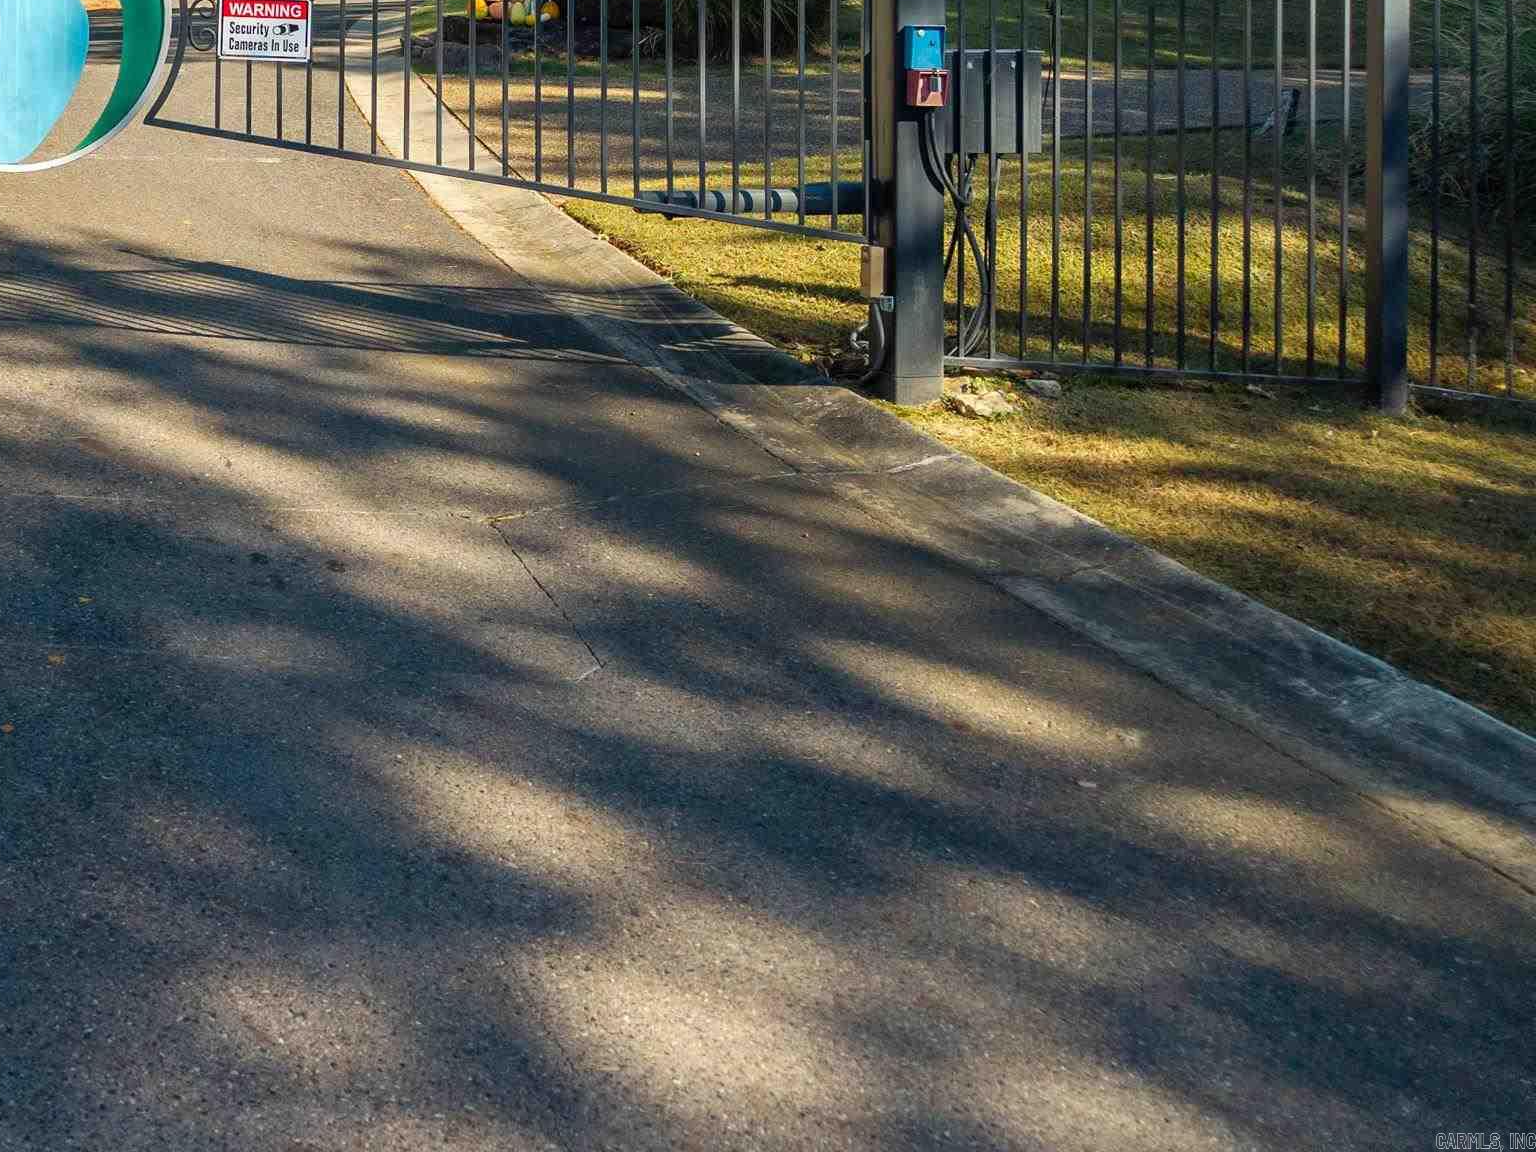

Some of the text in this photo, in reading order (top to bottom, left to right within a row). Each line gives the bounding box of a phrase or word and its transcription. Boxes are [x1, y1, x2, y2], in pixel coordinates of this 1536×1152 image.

[229, 2, 302, 18] WARNING
[229, 21, 270, 37] Security
[229, 37, 299, 53] Cameras In Use
